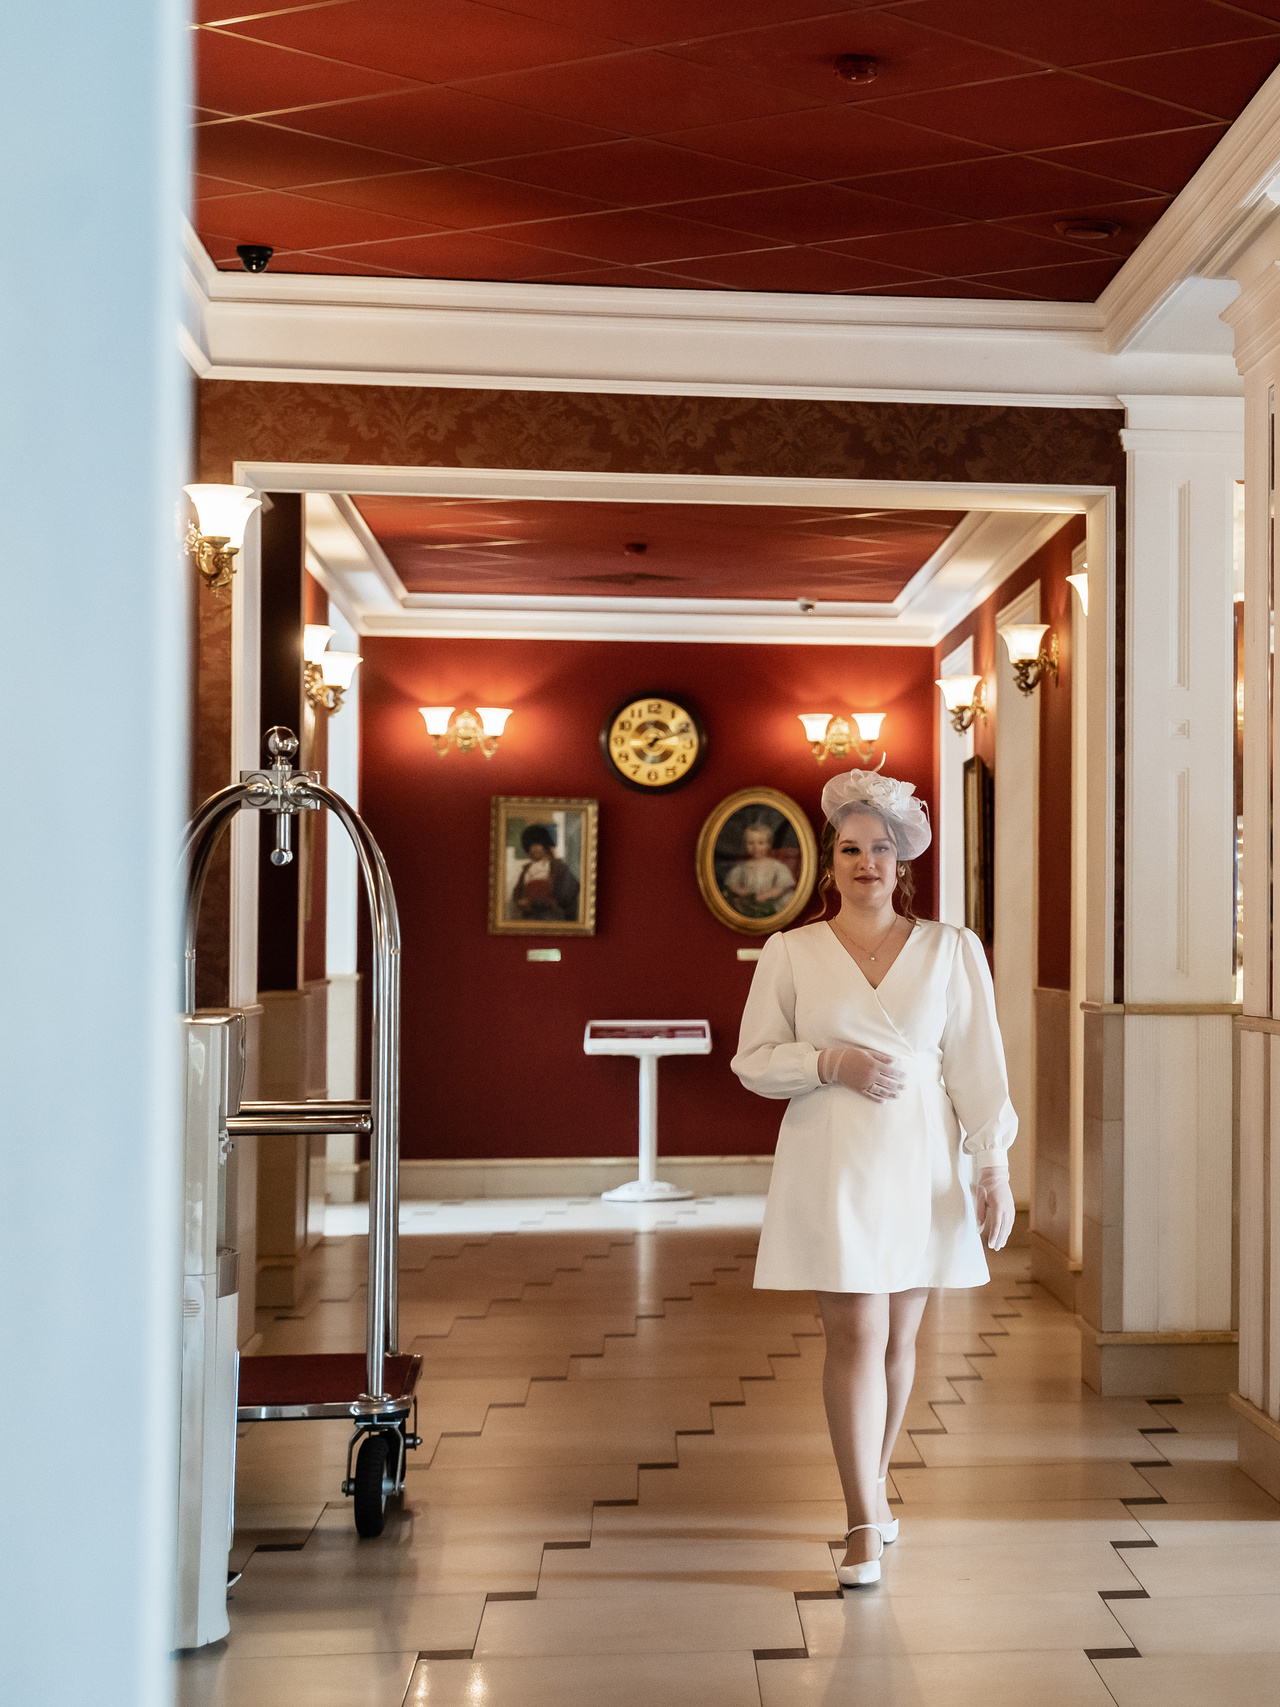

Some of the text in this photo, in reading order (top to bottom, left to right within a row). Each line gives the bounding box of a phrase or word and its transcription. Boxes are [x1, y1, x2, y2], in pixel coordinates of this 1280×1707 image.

[631, 709, 642, 718] 11
[648, 703, 661, 714] 12
[619, 720, 632, 732] 10
[679, 722, 691, 733] 2
[613, 735, 625, 747] 9
[682, 738, 693, 750] 3
[617, 750, 629, 763] 8
[676, 753, 687, 763] 4
[629, 763, 641, 775] 7
[665, 766, 676, 778] 5
[647, 769, 659, 782] 6
